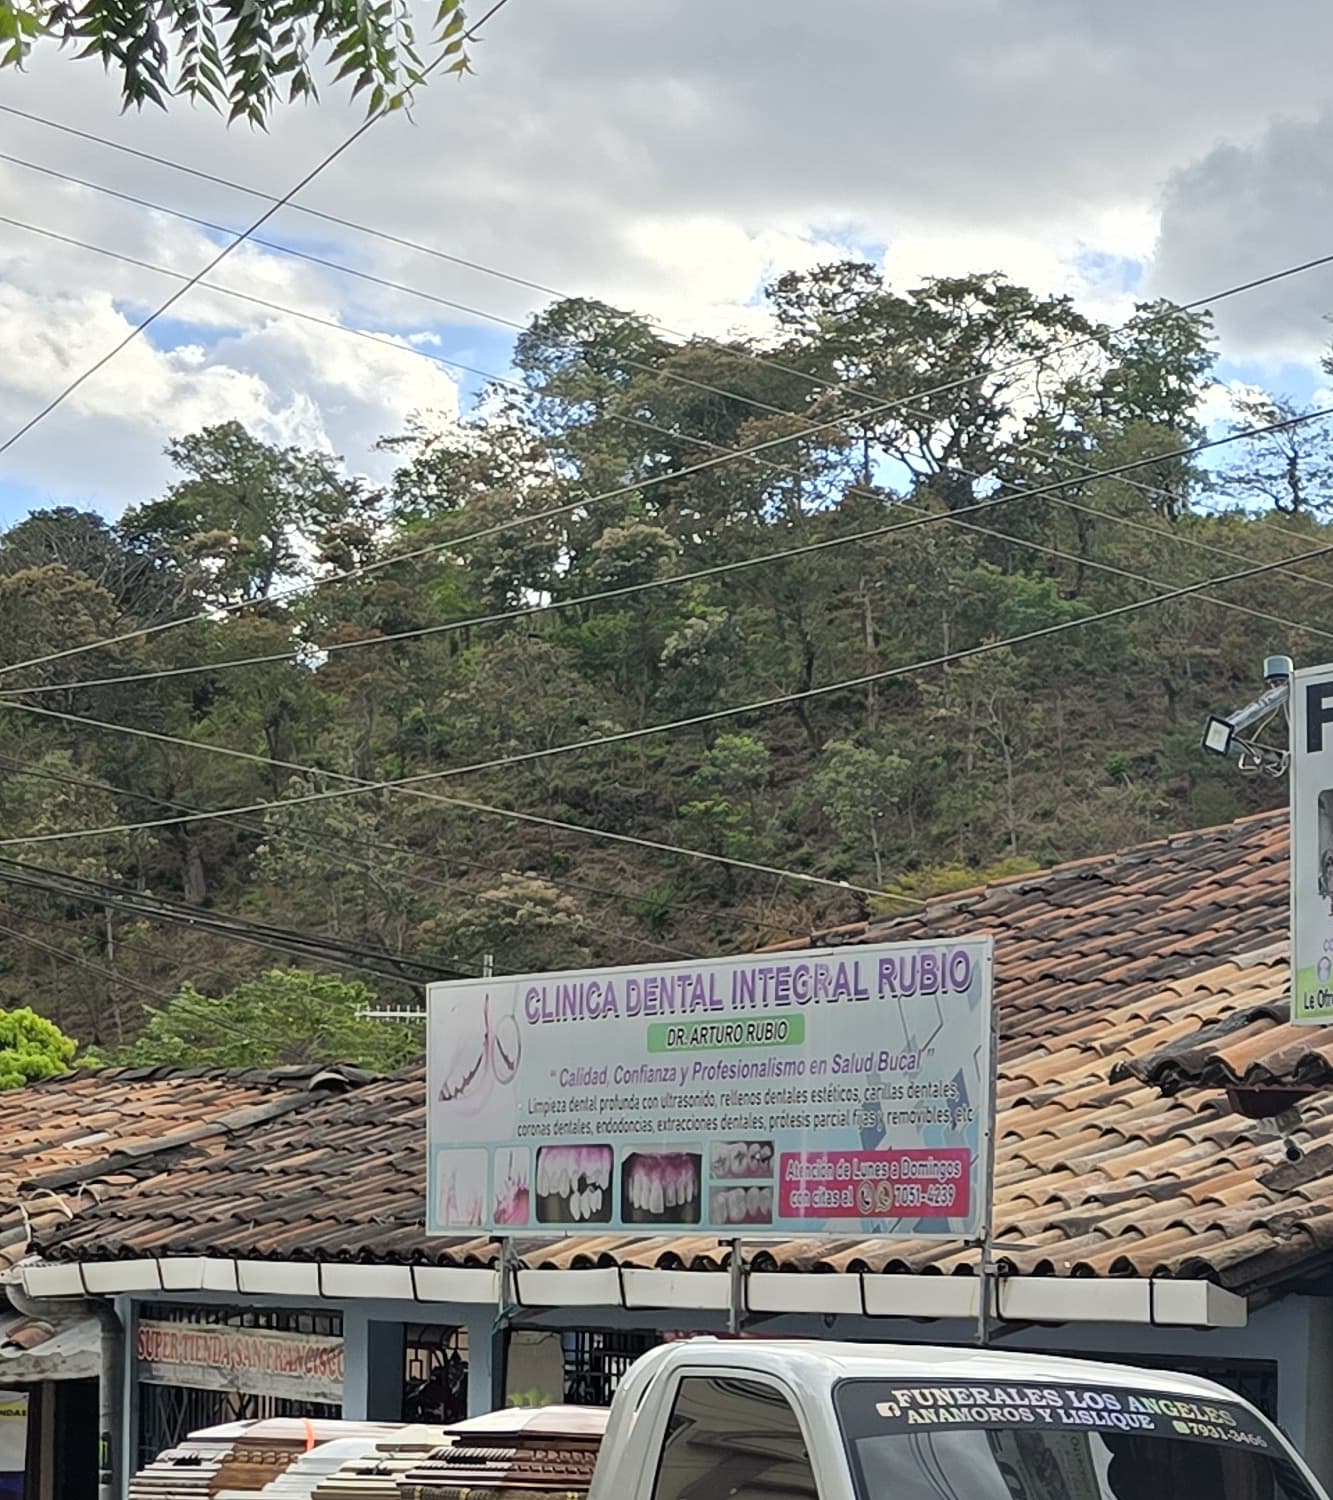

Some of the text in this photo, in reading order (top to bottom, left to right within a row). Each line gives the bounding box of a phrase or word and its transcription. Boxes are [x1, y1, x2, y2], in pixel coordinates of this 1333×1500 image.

[525, 950, 973, 1024] CLINICA DENTAL INTEGRAL RUBIO
[1303, 992, 1316, 1010] Le
[667, 1020, 788, 1047] DR. ARTURO RUBIO
[613, 1063, 677, 1085] Confianza
[679, 1066, 689, 1087] y
[692, 1056, 805, 1081] Profesionalismo
[809, 1059, 827, 1075] en
[831, 1052, 873, 1073] Salud
[877, 1049, 922, 1073] Bucal
[528, 1097, 567, 1117] Limpieza
[568, 1094, 598, 1113] dental
[599, 1094, 640, 1115] profunda
[641, 1096, 659, 1110] con
[661, 1091, 718, 1109] ultrasonido,
[719, 1088, 762, 1107] rellenos
[764, 1087, 808, 1105] dentales
[811, 1083, 862, 1104] estéticos,
[906, 1081, 960, 1101] dentales,
[517, 1121, 551, 1138] coronas
[552, 1118, 594, 1137] dentales,
[596, 1116, 655, 1135] endodoncias,
[657, 1115, 718, 1133] extracciones
[720, 1112, 767, 1132] dentales,
[769, 1107, 811, 1133] prótesis
[813, 1109, 850, 1131] parcial
[957, 1105, 974, 1123] etc
[785, 1156, 962, 1183] Atención de Lunes a Domingos
[790, 1191, 811, 1208] con
[812, 1186, 840, 1208] citas
[138, 1329, 263, 1370] SUPER TIENDA SAN
[891, 1387, 1238, 1427] FUNERALES LOS ANGELES
[907, 1407, 1155, 1431] ANAMOROS Y LISLIQUE
